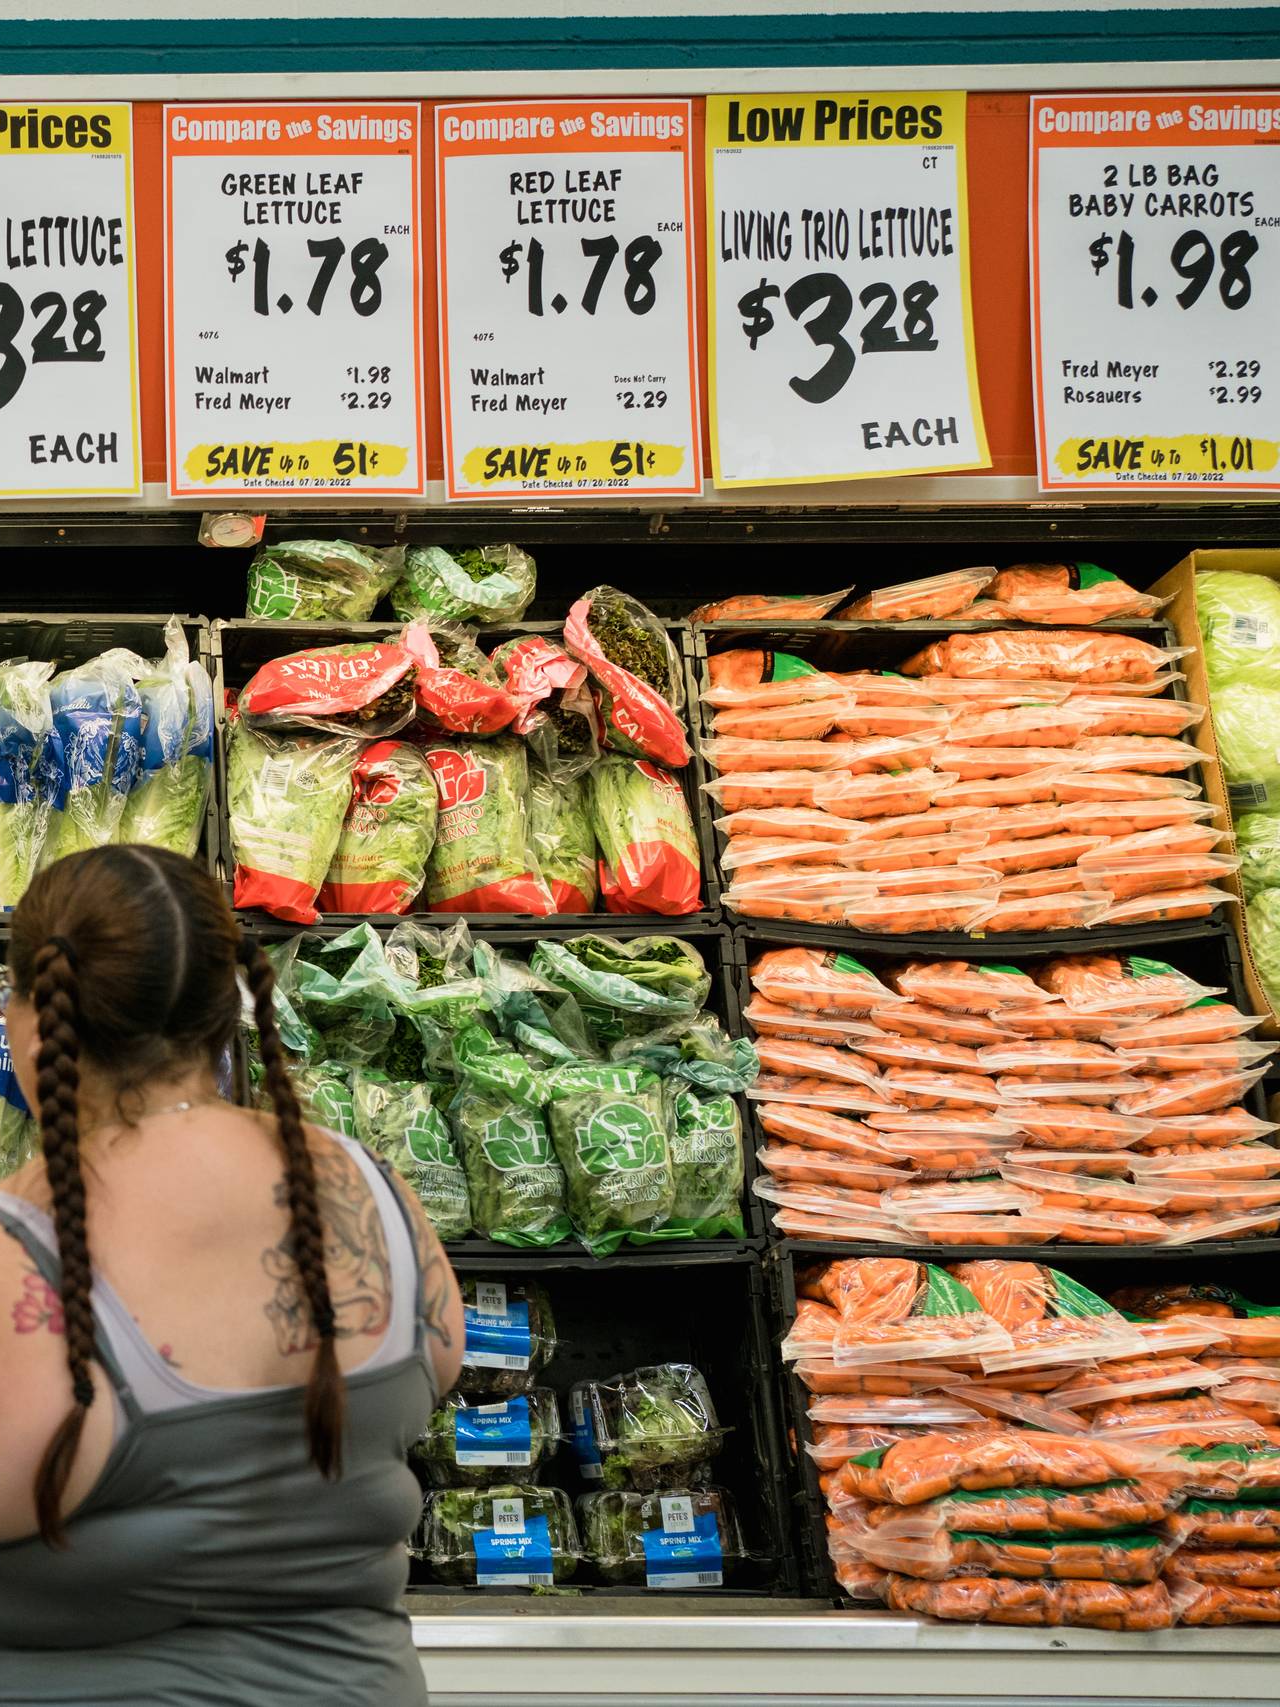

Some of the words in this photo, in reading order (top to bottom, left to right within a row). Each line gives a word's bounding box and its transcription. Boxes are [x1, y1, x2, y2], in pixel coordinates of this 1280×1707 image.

[171, 116, 281, 143] Compare
[286, 119, 312, 140] the
[317, 115, 413, 142] Savings
[443, 113, 554, 143] Compare
[559, 116, 586, 137] the
[590, 112, 684, 139] Savings
[728, 102, 805, 142] Low
[815, 99, 942, 140] Prices
[1038, 107, 1151, 134] Compare
[1156, 110, 1184, 130] the
[923, 157, 937, 169] CT
[221, 174, 296, 196] GREEN
[307, 173, 362, 195] LEAF
[510, 171, 554, 195] RED
[566, 169, 621, 193] LEAF
[1104, 165, 1117, 187] 2
[1129, 164, 1157, 187] LB
[1168, 164, 1218, 187] BAG
[244, 201, 341, 225] LETTUCE
[518, 198, 615, 225] LETTUCE
[1069, 193, 1134, 217] BABY
[1145, 192, 1253, 217] CARROTS
[384, 225, 409, 234] EACH
[658, 222, 682, 231] EACH
[1255, 217, 1280, 227] EACH
[7, 216, 123, 270] LETTUCE
[722, 210, 791, 262] LIVING
[802, 208, 849, 261] TRIO
[859, 207, 953, 260] LETTUCE
[225, 237, 389, 316] $1.78
[499, 235, 662, 316] $1.78
[1089, 230, 1259, 310] $1.98
[195, 366, 269, 384] Walmart
[347, 367, 390, 383] $1.98
[471, 367, 544, 386] Walmart
[648, 375, 666, 383] Carry
[1062, 360, 1098, 377] Fred
[1107, 361, 1159, 380] Meyer
[1209, 360, 1260, 378] $2.29
[195, 393, 231, 409] Fred
[240, 393, 291, 413] Meyer
[341, 392, 391, 409] $2.29
[471, 394, 507, 412] Fred
[516, 395, 567, 415] Meyer
[617, 391, 667, 409] $2.29
[1064, 386, 1141, 403] Rosauers
[1210, 386, 1261, 403] $2.99
[861, 417, 958, 450] EACH
[29, 432, 117, 464] EACH
[1077, 440, 1144, 471] SAVE
[1151, 450, 1164, 466] Up
[1170, 450, 1180, 464] To
[1200, 437, 1253, 470] $1.01
[206, 446, 273, 477] SAVE
[280, 456, 293, 473] Up
[298, 455, 309, 470] To
[333, 443, 378, 475] 51¢
[484, 448, 550, 479] SAVE
[558, 456, 571, 474] Up
[576, 456, 586, 471] To
[610, 443, 655, 475] 51¢
[299, 478, 352, 488] 07/20/2022
[543, 479, 573, 489] Checked
[577, 478, 629, 488] 07/20/2022
[1172, 473, 1223, 481] 07/20/2022
[596, 1111, 644, 1161] SF
[600, 1169, 667, 1190] STERINO
[610, 1186, 660, 1204] FARMS
[473, 1417, 497, 1425] SPRING
[498, 1416, 512, 1424] MIX
[498, 1513, 519, 1523] PETE'S
[667, 1512, 689, 1522] PETE'S
[490, 1538, 517, 1546] SPRING
[518, 1537, 532, 1546] MIX
[659, 1537, 687, 1545] SPRING
[688, 1536, 702, 1544] MIX
